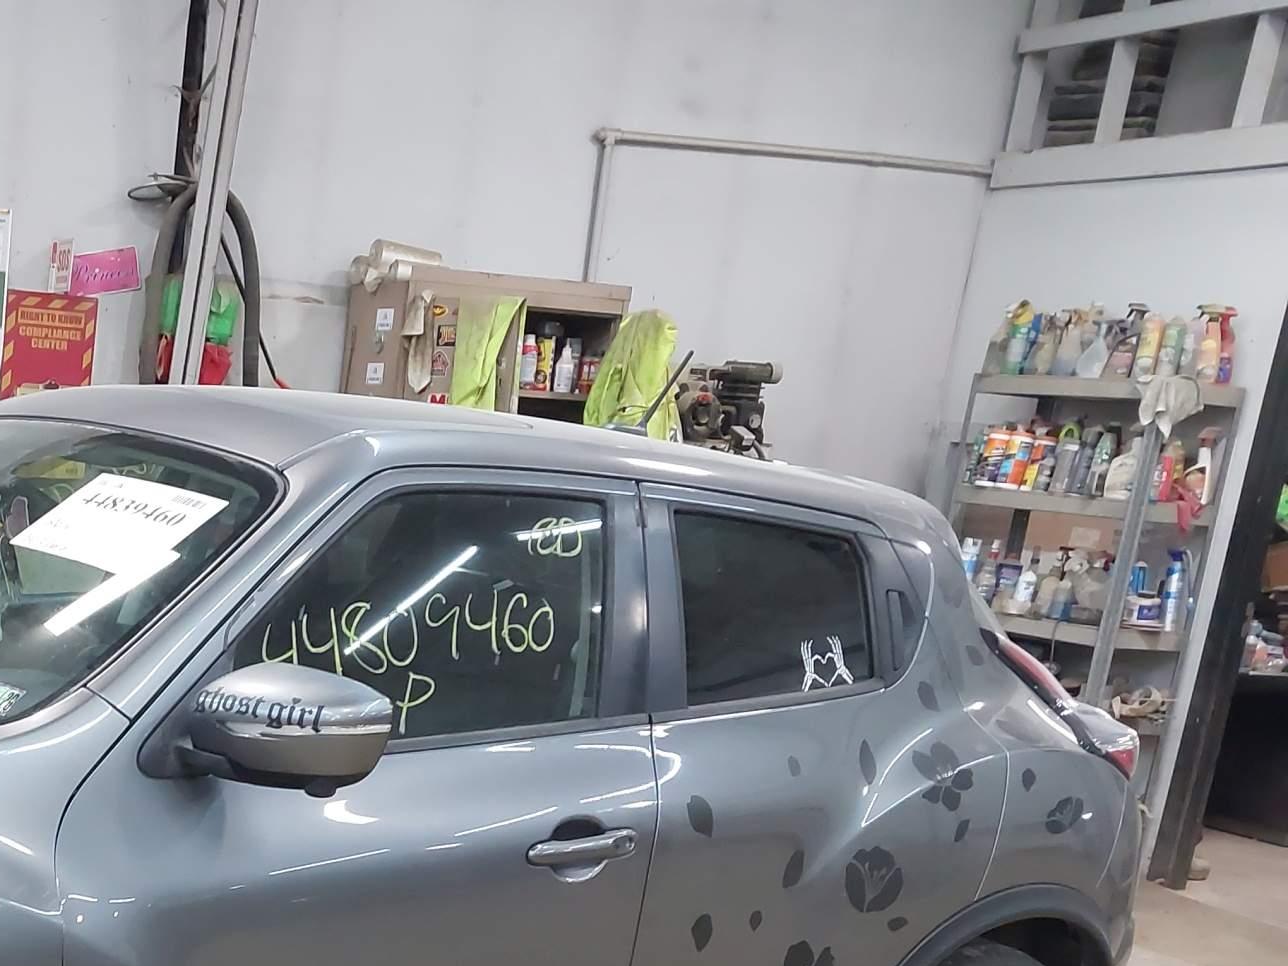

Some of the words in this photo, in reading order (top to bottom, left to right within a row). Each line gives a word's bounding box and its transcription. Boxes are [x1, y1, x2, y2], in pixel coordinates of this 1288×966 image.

[20, 310, 44, 322] RIGHT
[19, 325, 81, 341] COMPLIANCE
[31, 338, 68, 351] CENTER
[192, 686, 266, 719] ghost
[266, 697, 325, 733] girl
